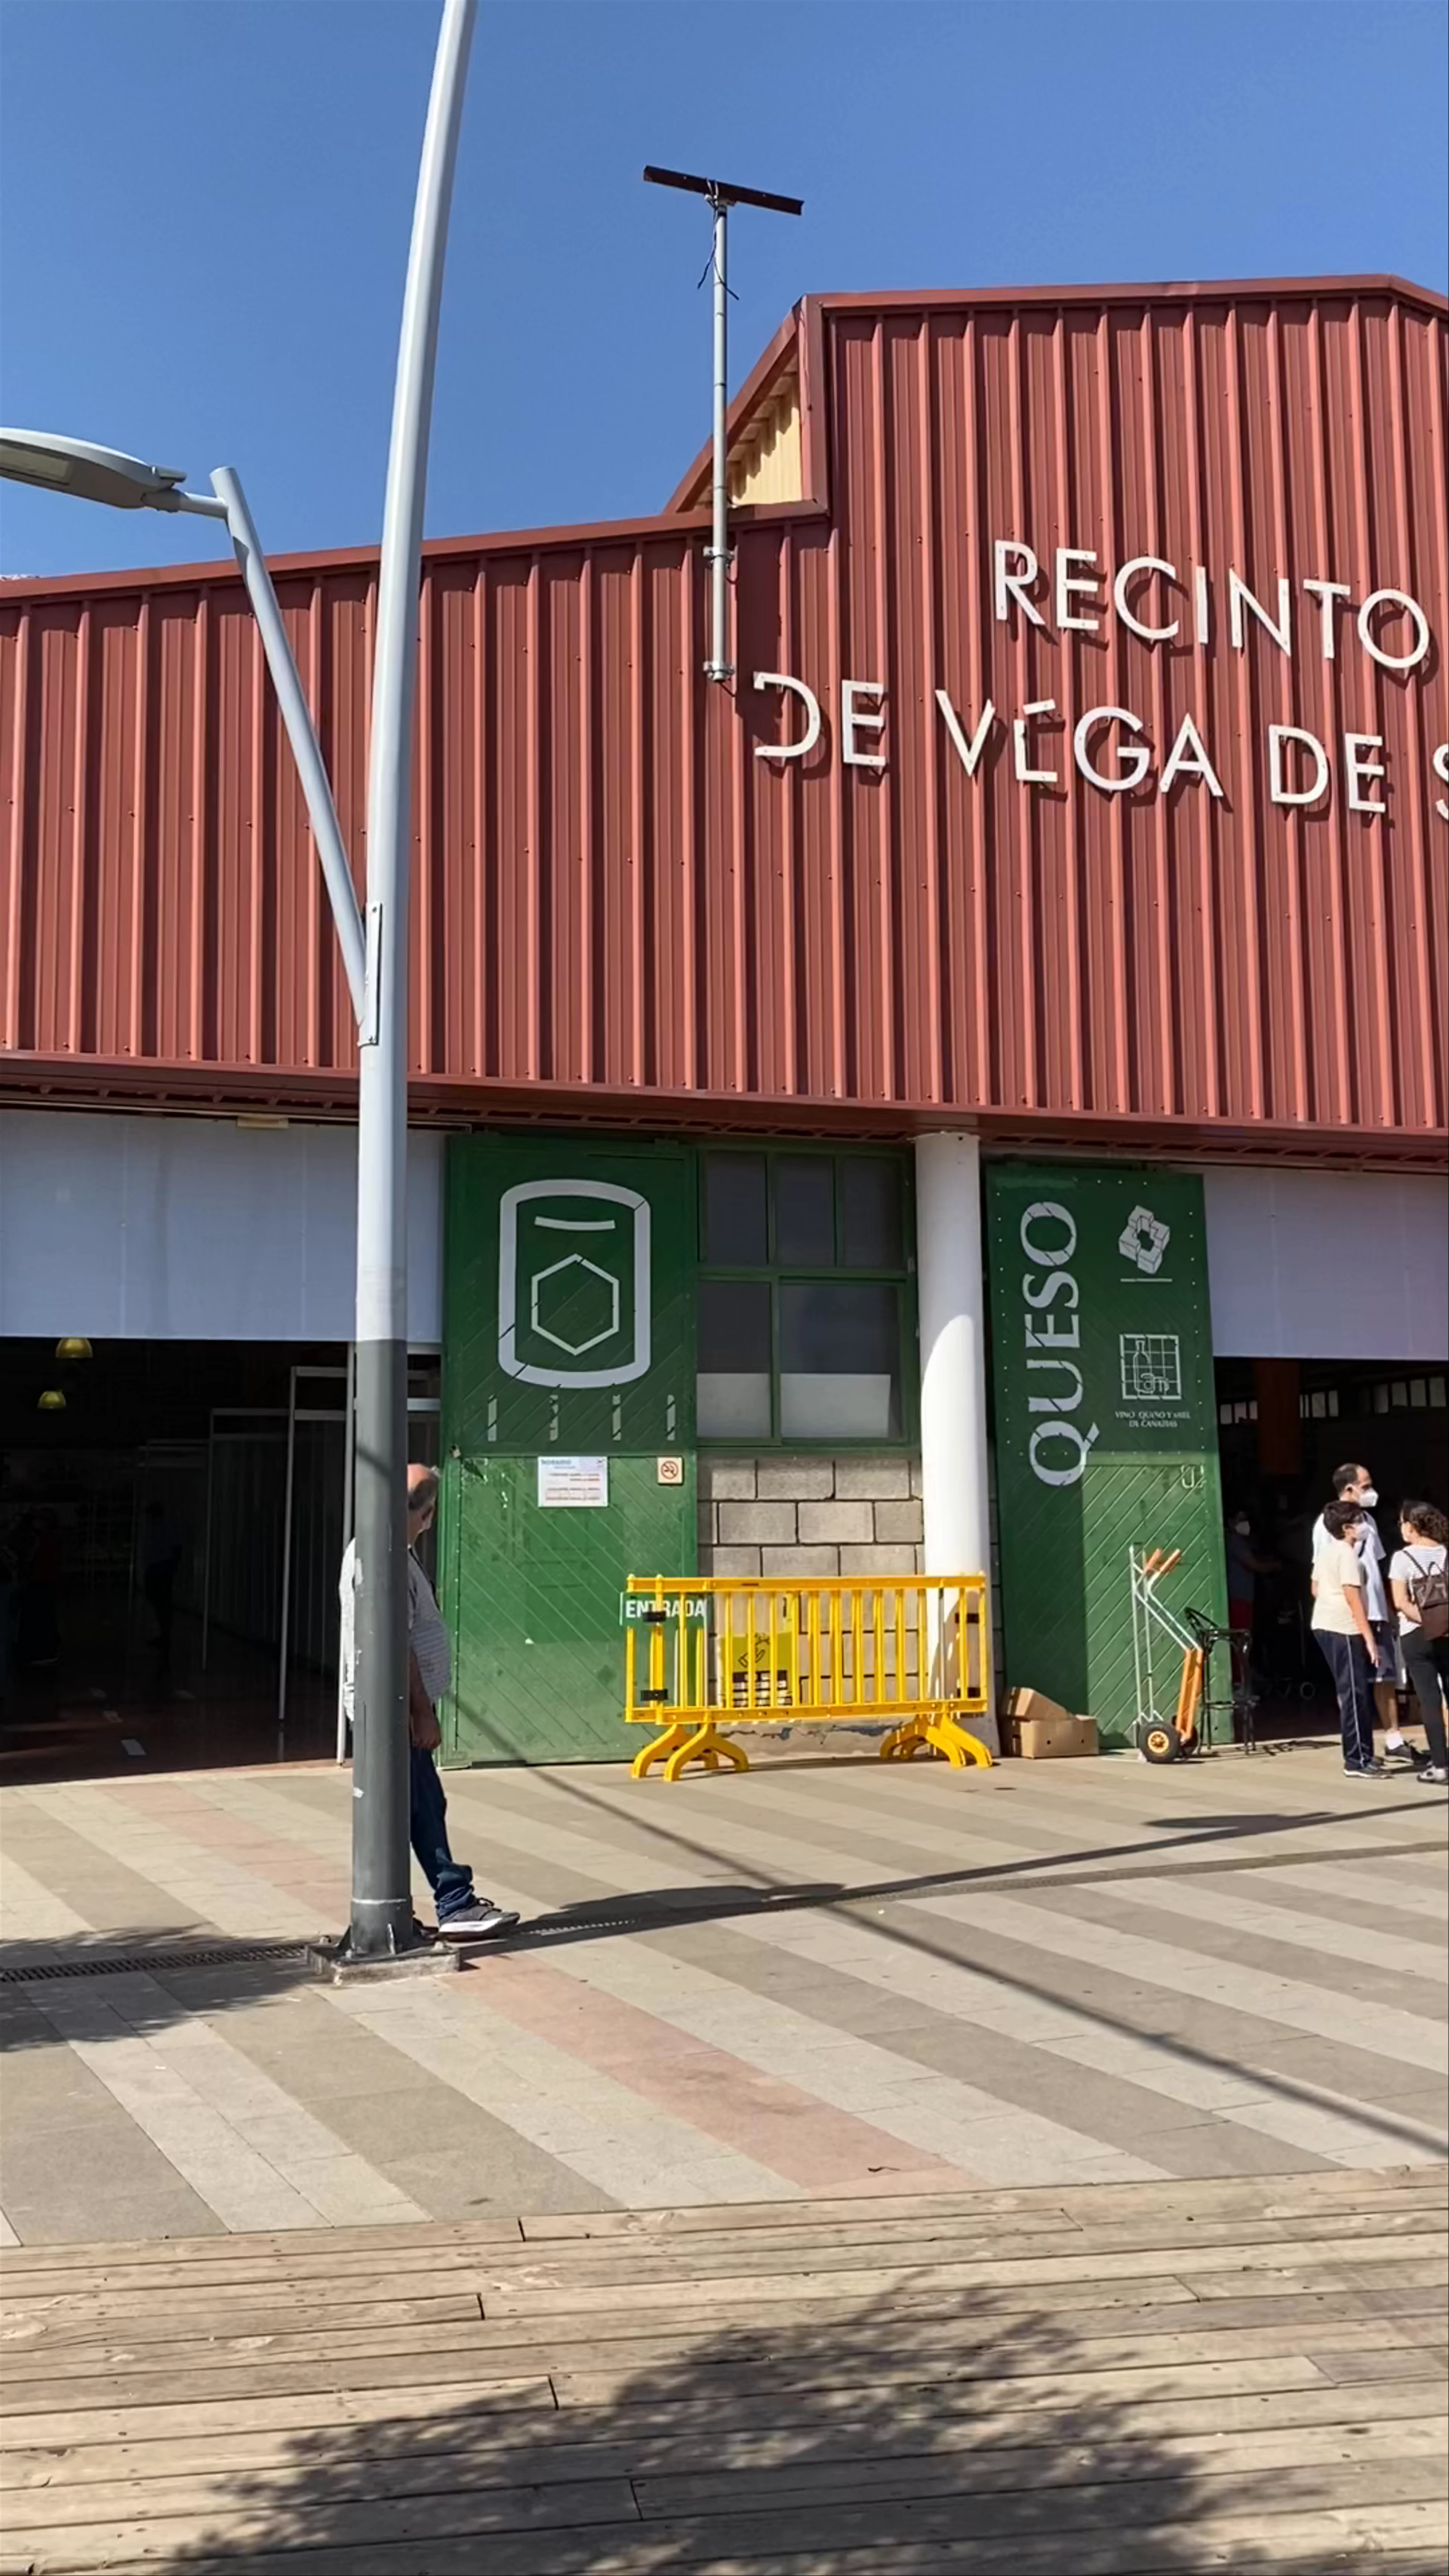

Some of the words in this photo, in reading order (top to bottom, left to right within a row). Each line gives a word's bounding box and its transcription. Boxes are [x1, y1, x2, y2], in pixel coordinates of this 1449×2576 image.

[994, 539, 1429, 677] RECINTO
[754, 671, 886, 767] DE
[1268, 724, 1386, 813] DE
[1020, 1201, 1100, 1486] QUESO
